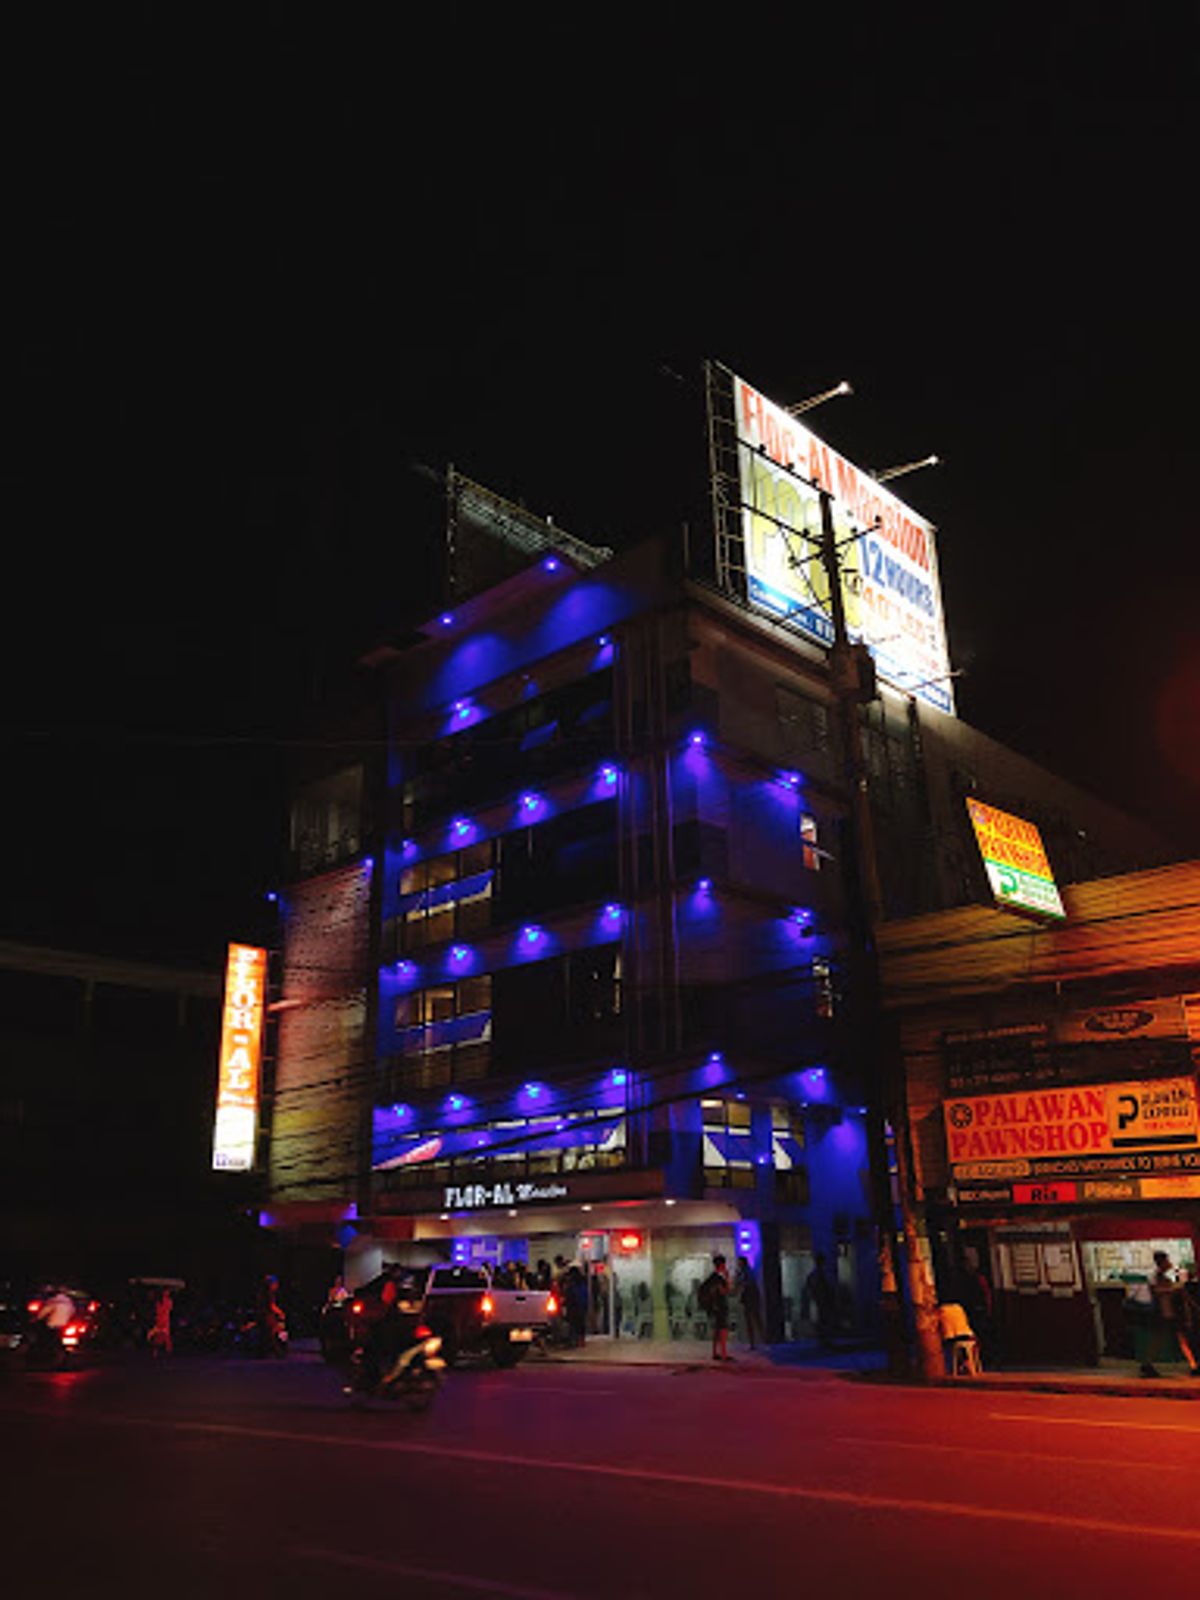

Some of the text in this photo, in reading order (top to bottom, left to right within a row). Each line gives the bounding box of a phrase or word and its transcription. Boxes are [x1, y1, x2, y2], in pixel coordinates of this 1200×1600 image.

[974, 1089, 1106, 1127] PALAWAN
[951, 1121, 1109, 1158] PAWNSHOP
[443, 1183, 515, 1209] FLOR-AL
